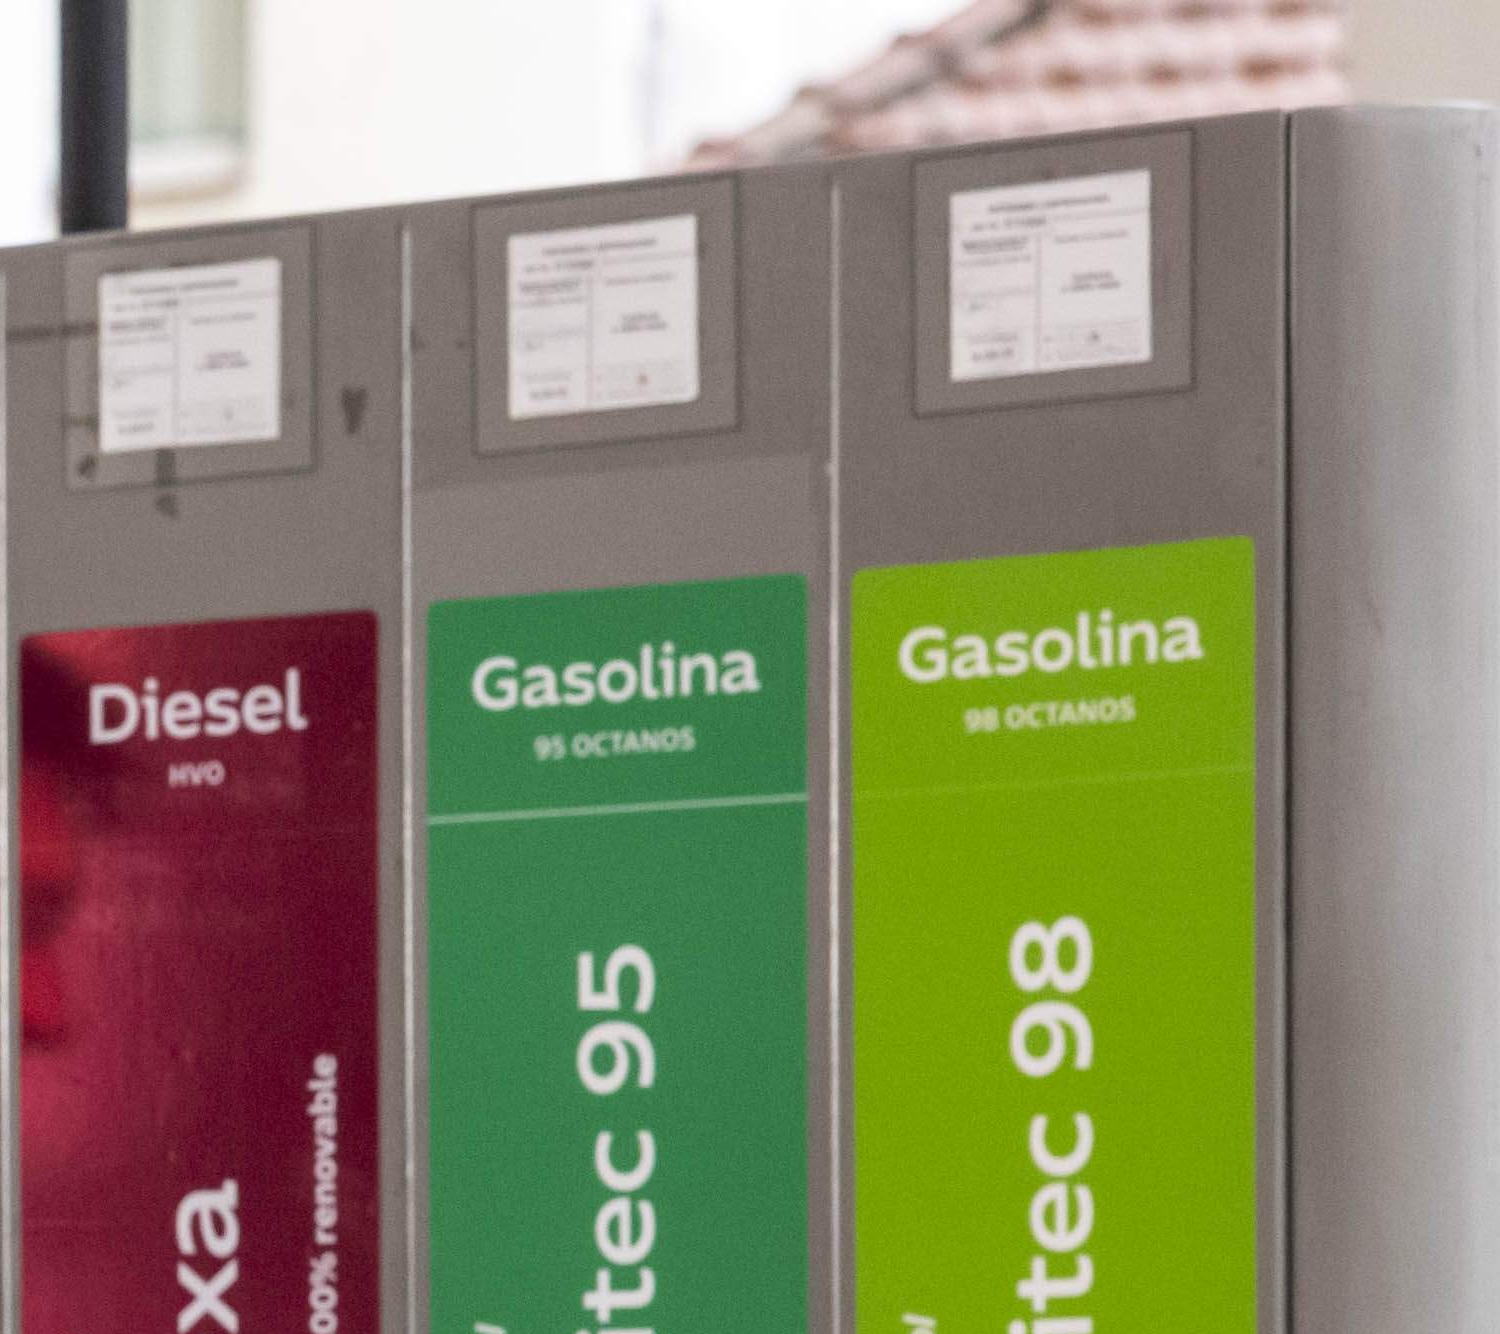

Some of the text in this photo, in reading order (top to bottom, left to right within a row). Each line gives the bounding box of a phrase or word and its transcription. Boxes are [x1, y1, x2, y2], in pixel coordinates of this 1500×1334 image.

[470, 641, 762, 712] Gasolina
[898, 608, 1205, 684] Gasolina
[89, 667, 309, 745] Diesel
[533, 726, 696, 761] 95 OCTANOS
[963, 695, 1138, 734] 98 OCTANOS
[167, 759, 226, 788] HVO
[576, 944, 656, 1096] 95
[1009, 915, 1093, 1078] 98
[307, 1053, 339, 1246] renovable
